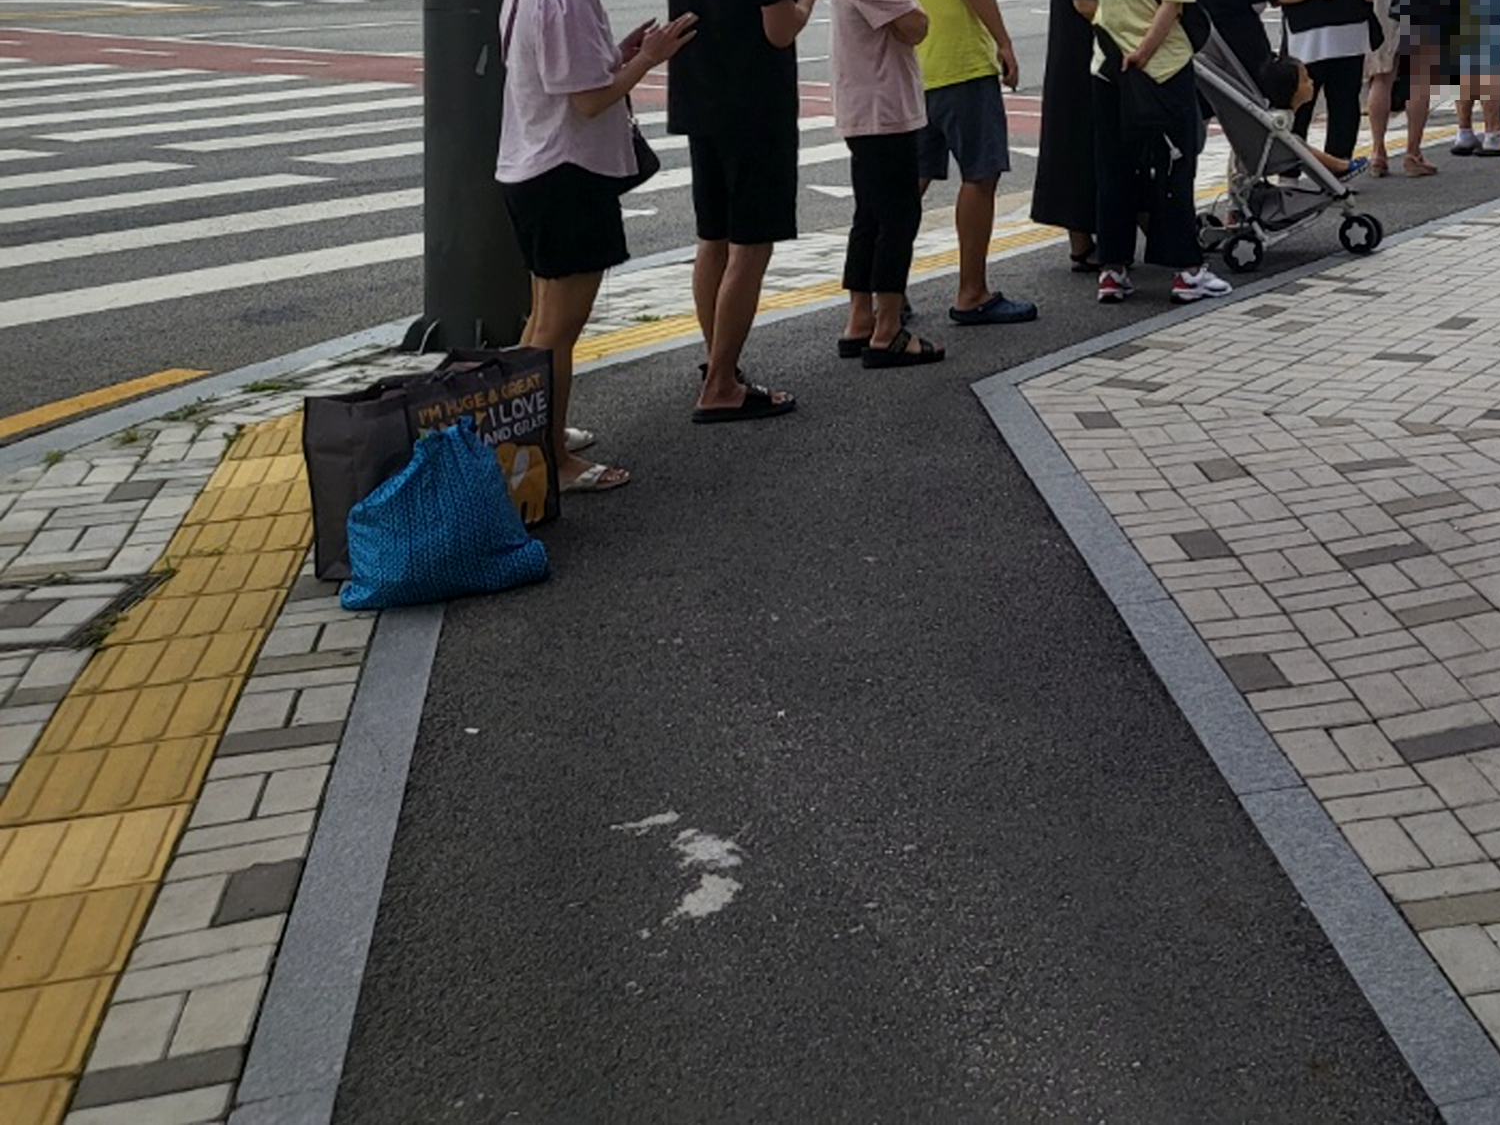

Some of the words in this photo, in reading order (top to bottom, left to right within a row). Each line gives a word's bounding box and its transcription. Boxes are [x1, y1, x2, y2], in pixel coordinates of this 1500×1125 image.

[444, 391, 486, 415] HUGE
[502, 373, 541, 398] GREAT
[488, 407, 496, 427] I
[500, 390, 547, 423] LOVE
